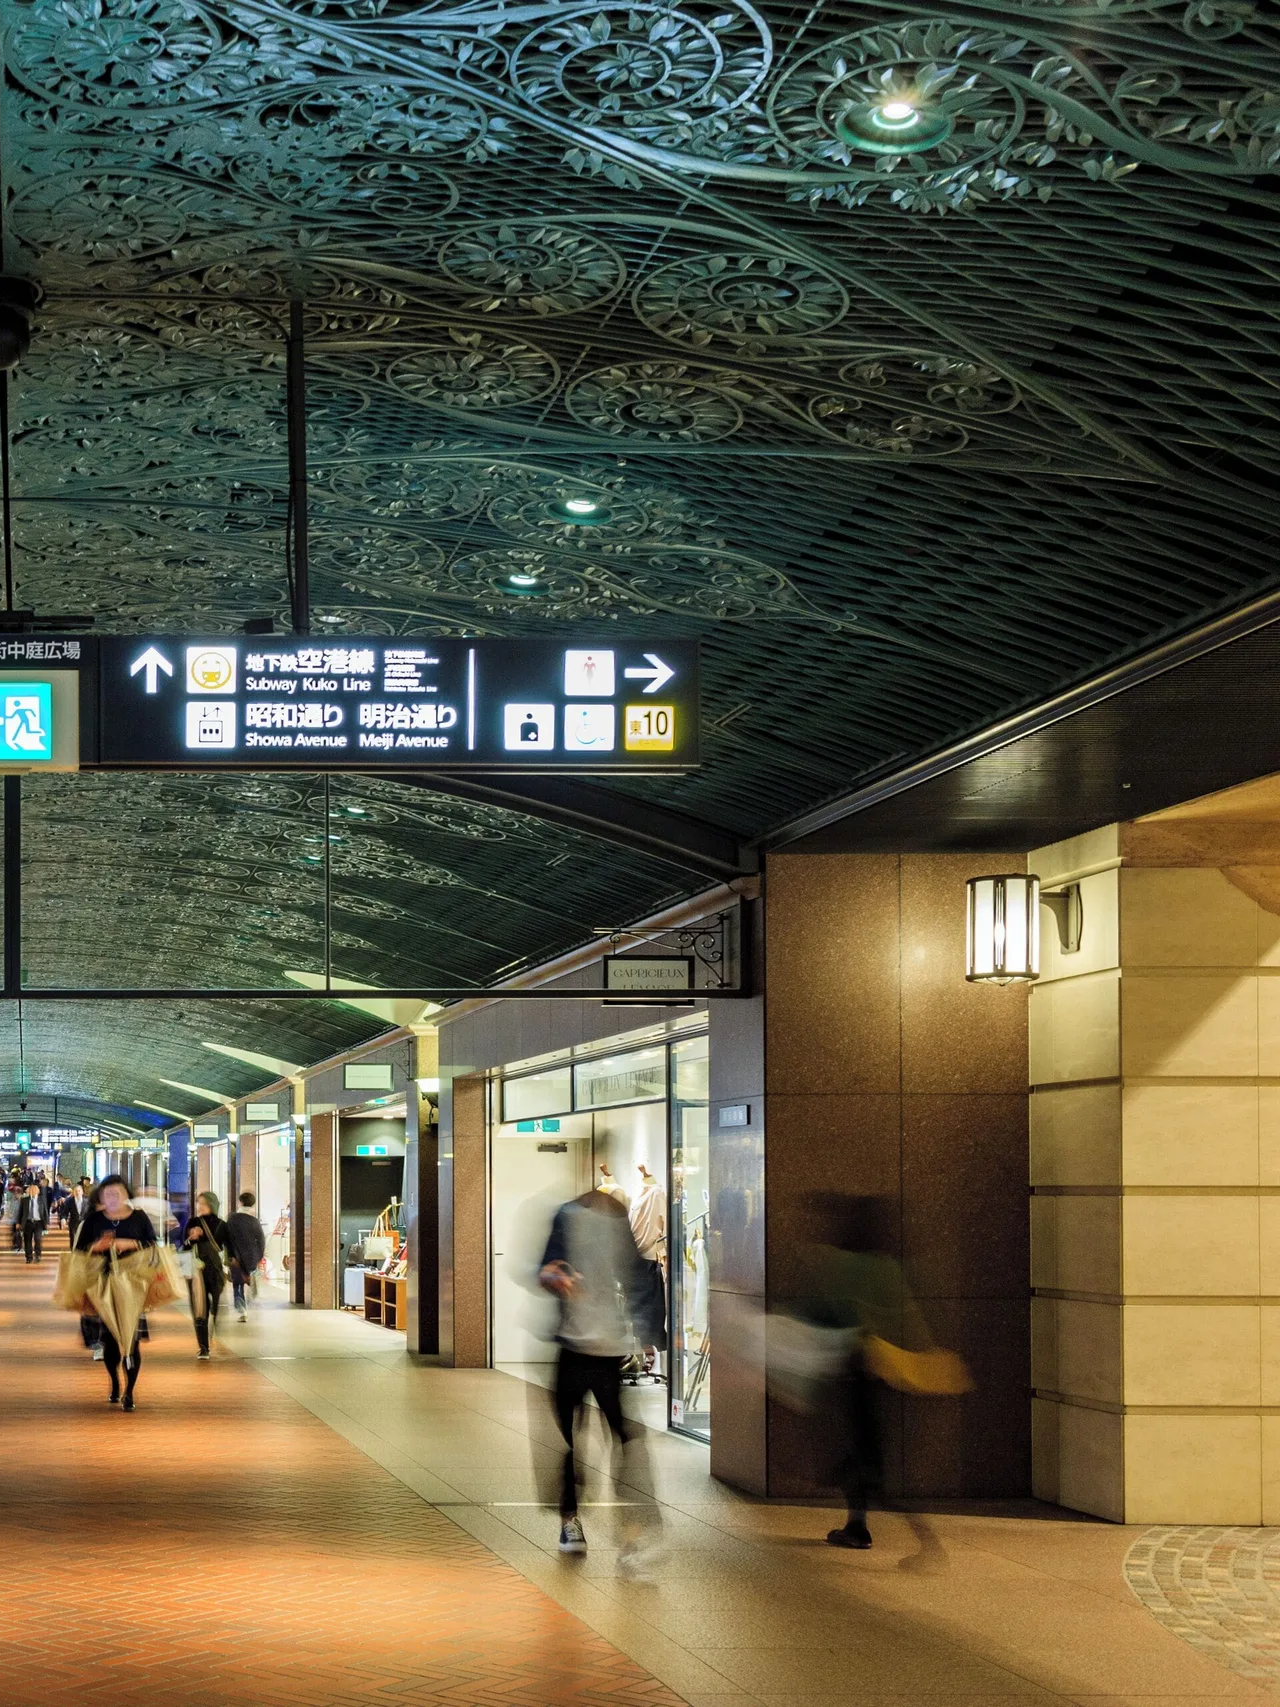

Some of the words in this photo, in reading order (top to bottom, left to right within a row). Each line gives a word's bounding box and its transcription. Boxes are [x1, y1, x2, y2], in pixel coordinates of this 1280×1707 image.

[245, 677, 297, 694] Subway
[303, 677, 338, 691] Kuko
[343, 677, 371, 691] Line
[245, 703, 343, 728] 昭和通り
[359, 703, 458, 729] 明治通り
[245, 733, 294, 747] Showa
[294, 733, 348, 747] Avenue
[359, 733, 395, 749] Meiji
[395, 733, 449, 748] Avenue
[613, 968, 685, 978] CAPRICIEUX
